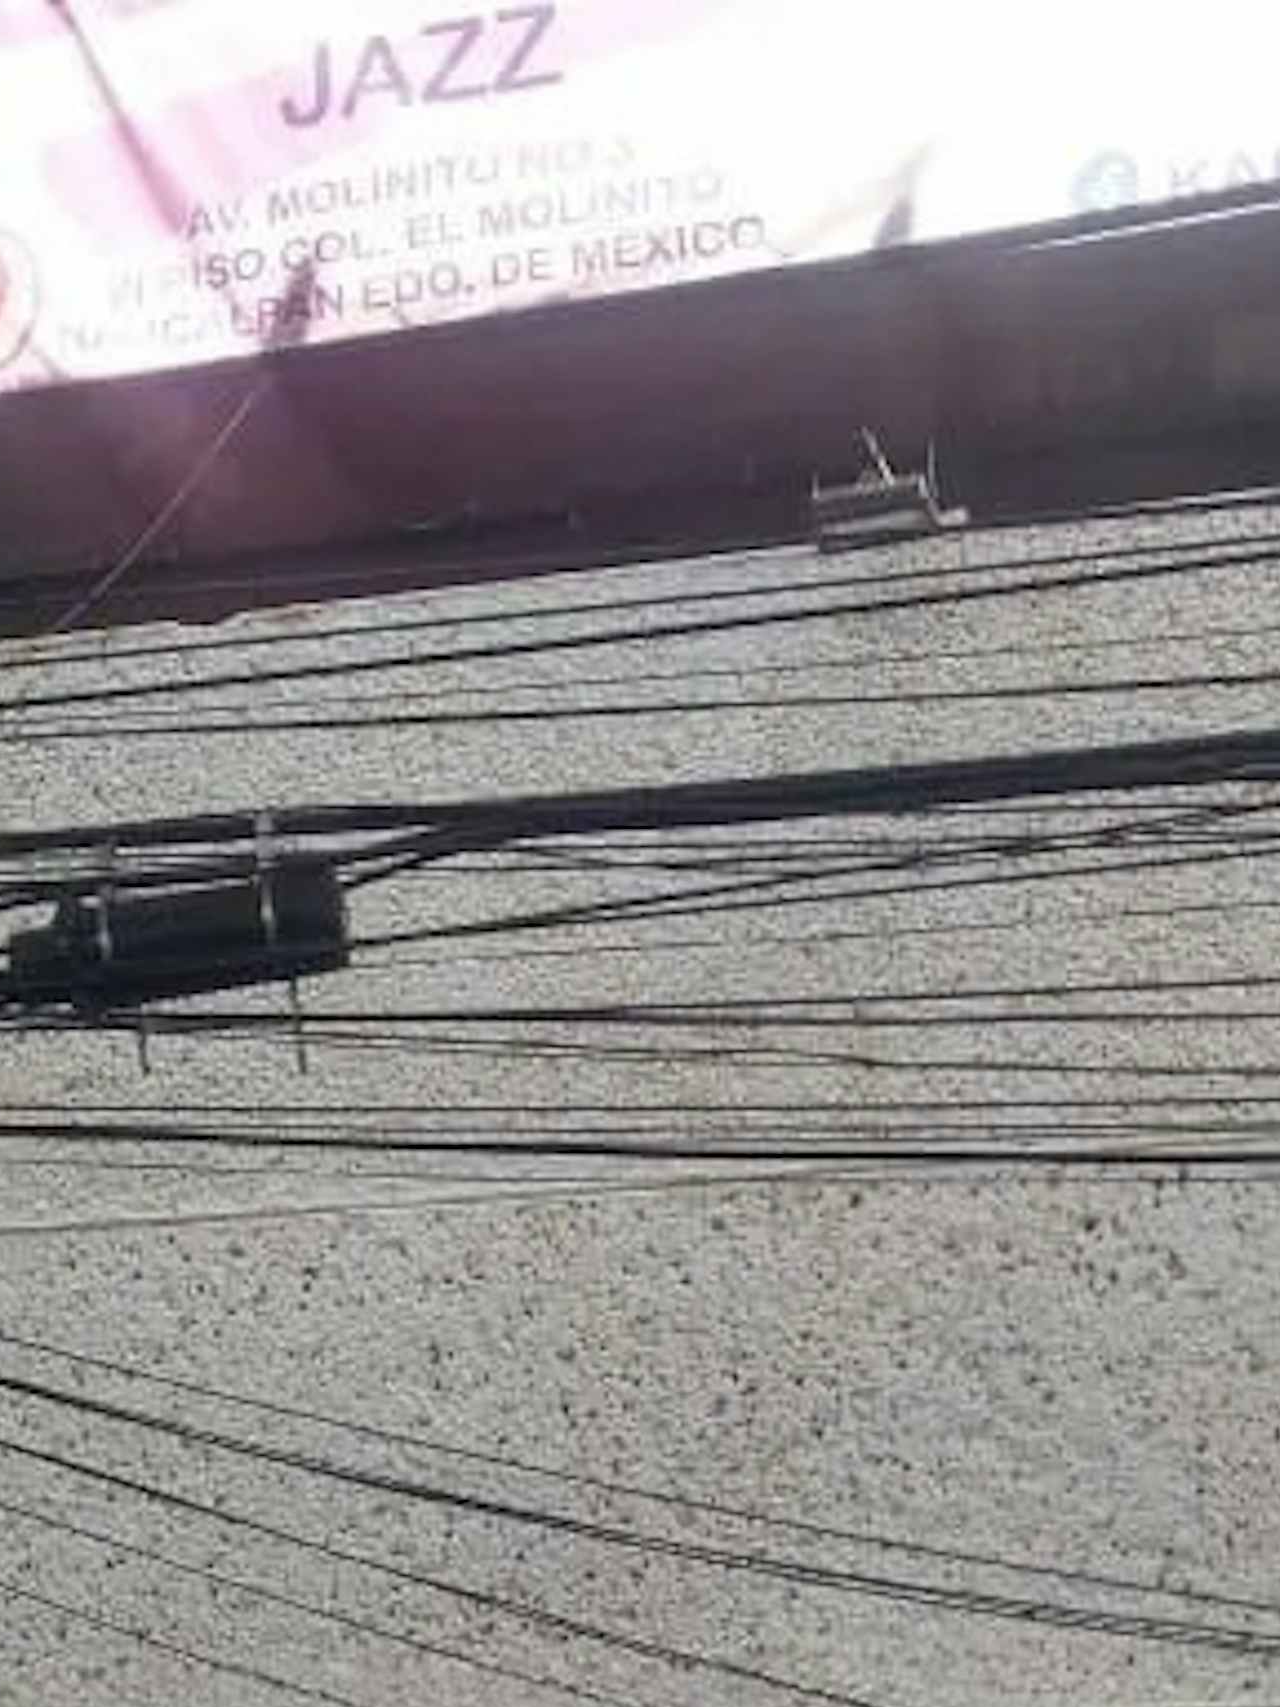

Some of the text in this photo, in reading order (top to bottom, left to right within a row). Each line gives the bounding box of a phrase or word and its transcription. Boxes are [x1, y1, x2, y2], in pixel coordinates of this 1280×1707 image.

[278, 2, 564, 128] JAZZ
[404, 208, 466, 251] EL
[476, 163, 728, 240] MOLINITO
[361, 257, 478, 312] EDO.
[489, 245, 552, 290] DE
[570, 211, 767, 277] MEXICO
